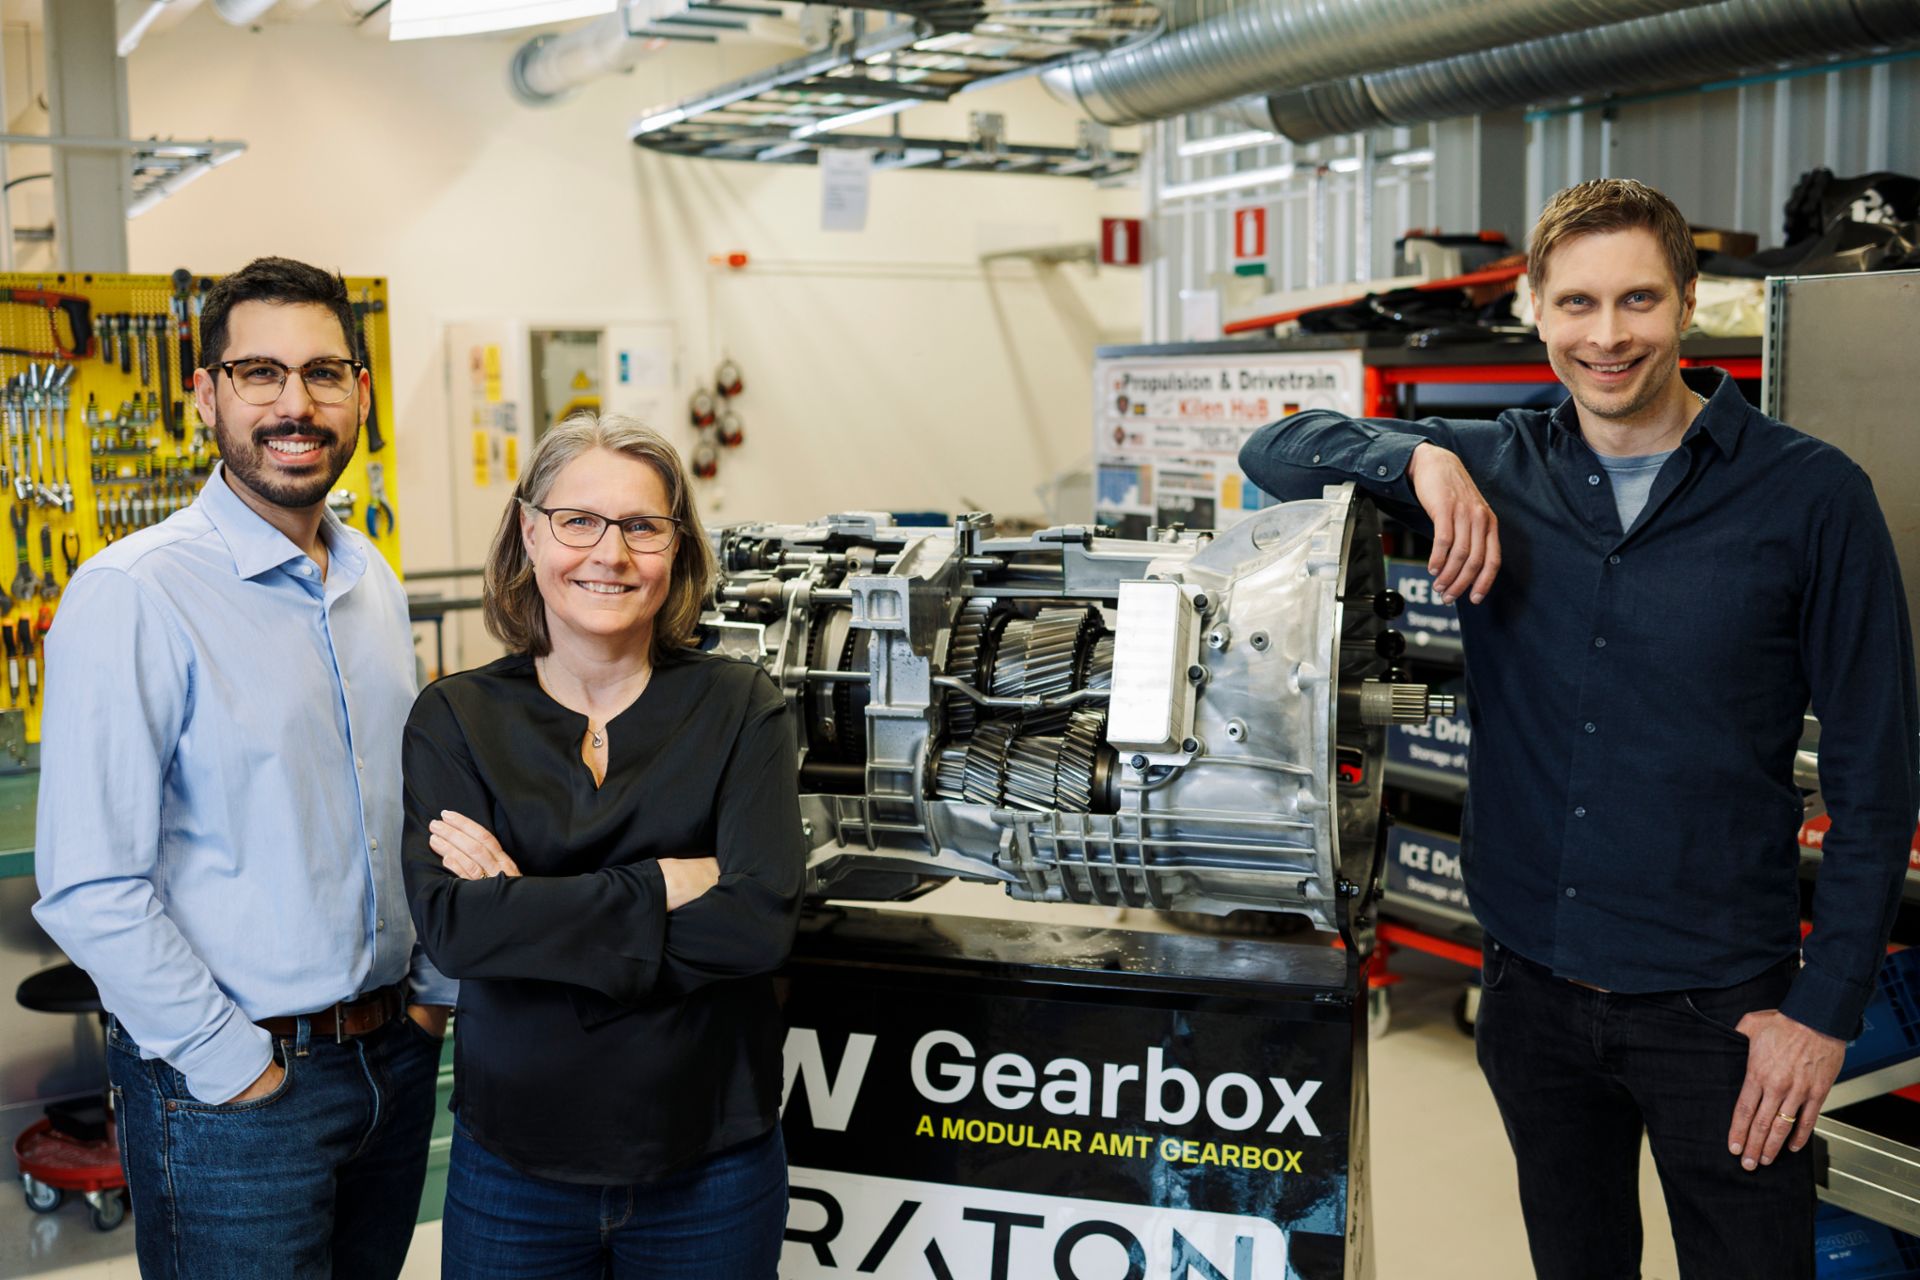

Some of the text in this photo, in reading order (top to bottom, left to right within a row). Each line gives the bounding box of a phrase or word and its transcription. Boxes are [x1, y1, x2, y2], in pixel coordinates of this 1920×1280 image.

[1220, 371, 1231, 390] &
[1239, 370, 1336, 391] Drivetrain
[1398, 578, 1430, 604] ICE
[1399, 842, 1429, 871] ICE
[910, 1029, 1323, 1137] Gearbox
[915, 1115, 1303, 1173] A MODULAR AMT GEARBOX
